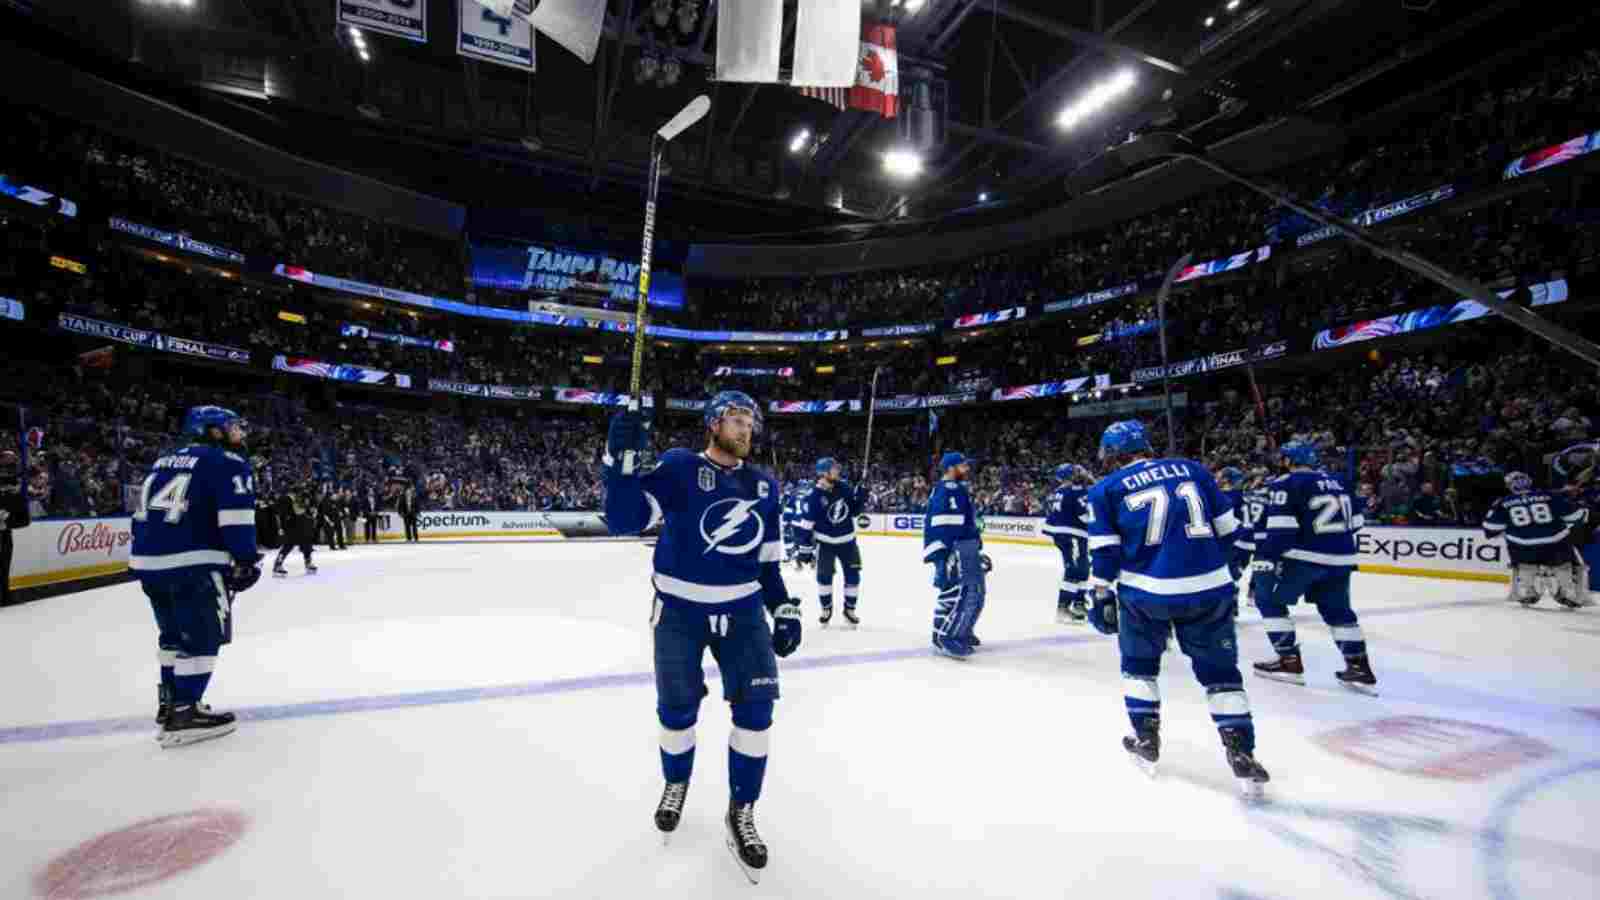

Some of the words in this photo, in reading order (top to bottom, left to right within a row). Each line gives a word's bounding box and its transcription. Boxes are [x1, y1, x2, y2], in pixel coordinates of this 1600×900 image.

[527, 246, 596, 274] TAMPA
[600, 256, 641, 283] BAY
[61, 317, 119, 338] STANLEY
[122, 329, 148, 343] CUP
[168, 338, 207, 354] FINAL
[1122, 463, 1190, 491] CIRELLI
[132, 472, 193, 524] 14
[1123, 481, 1214, 546] 71
[414, 513, 486, 530] Spectrum
[1240, 503, 1265, 528] 19
[1508, 502, 1552, 527] 88
[58, 522, 113, 555] Bally
[1355, 533, 1501, 562] Expedia
